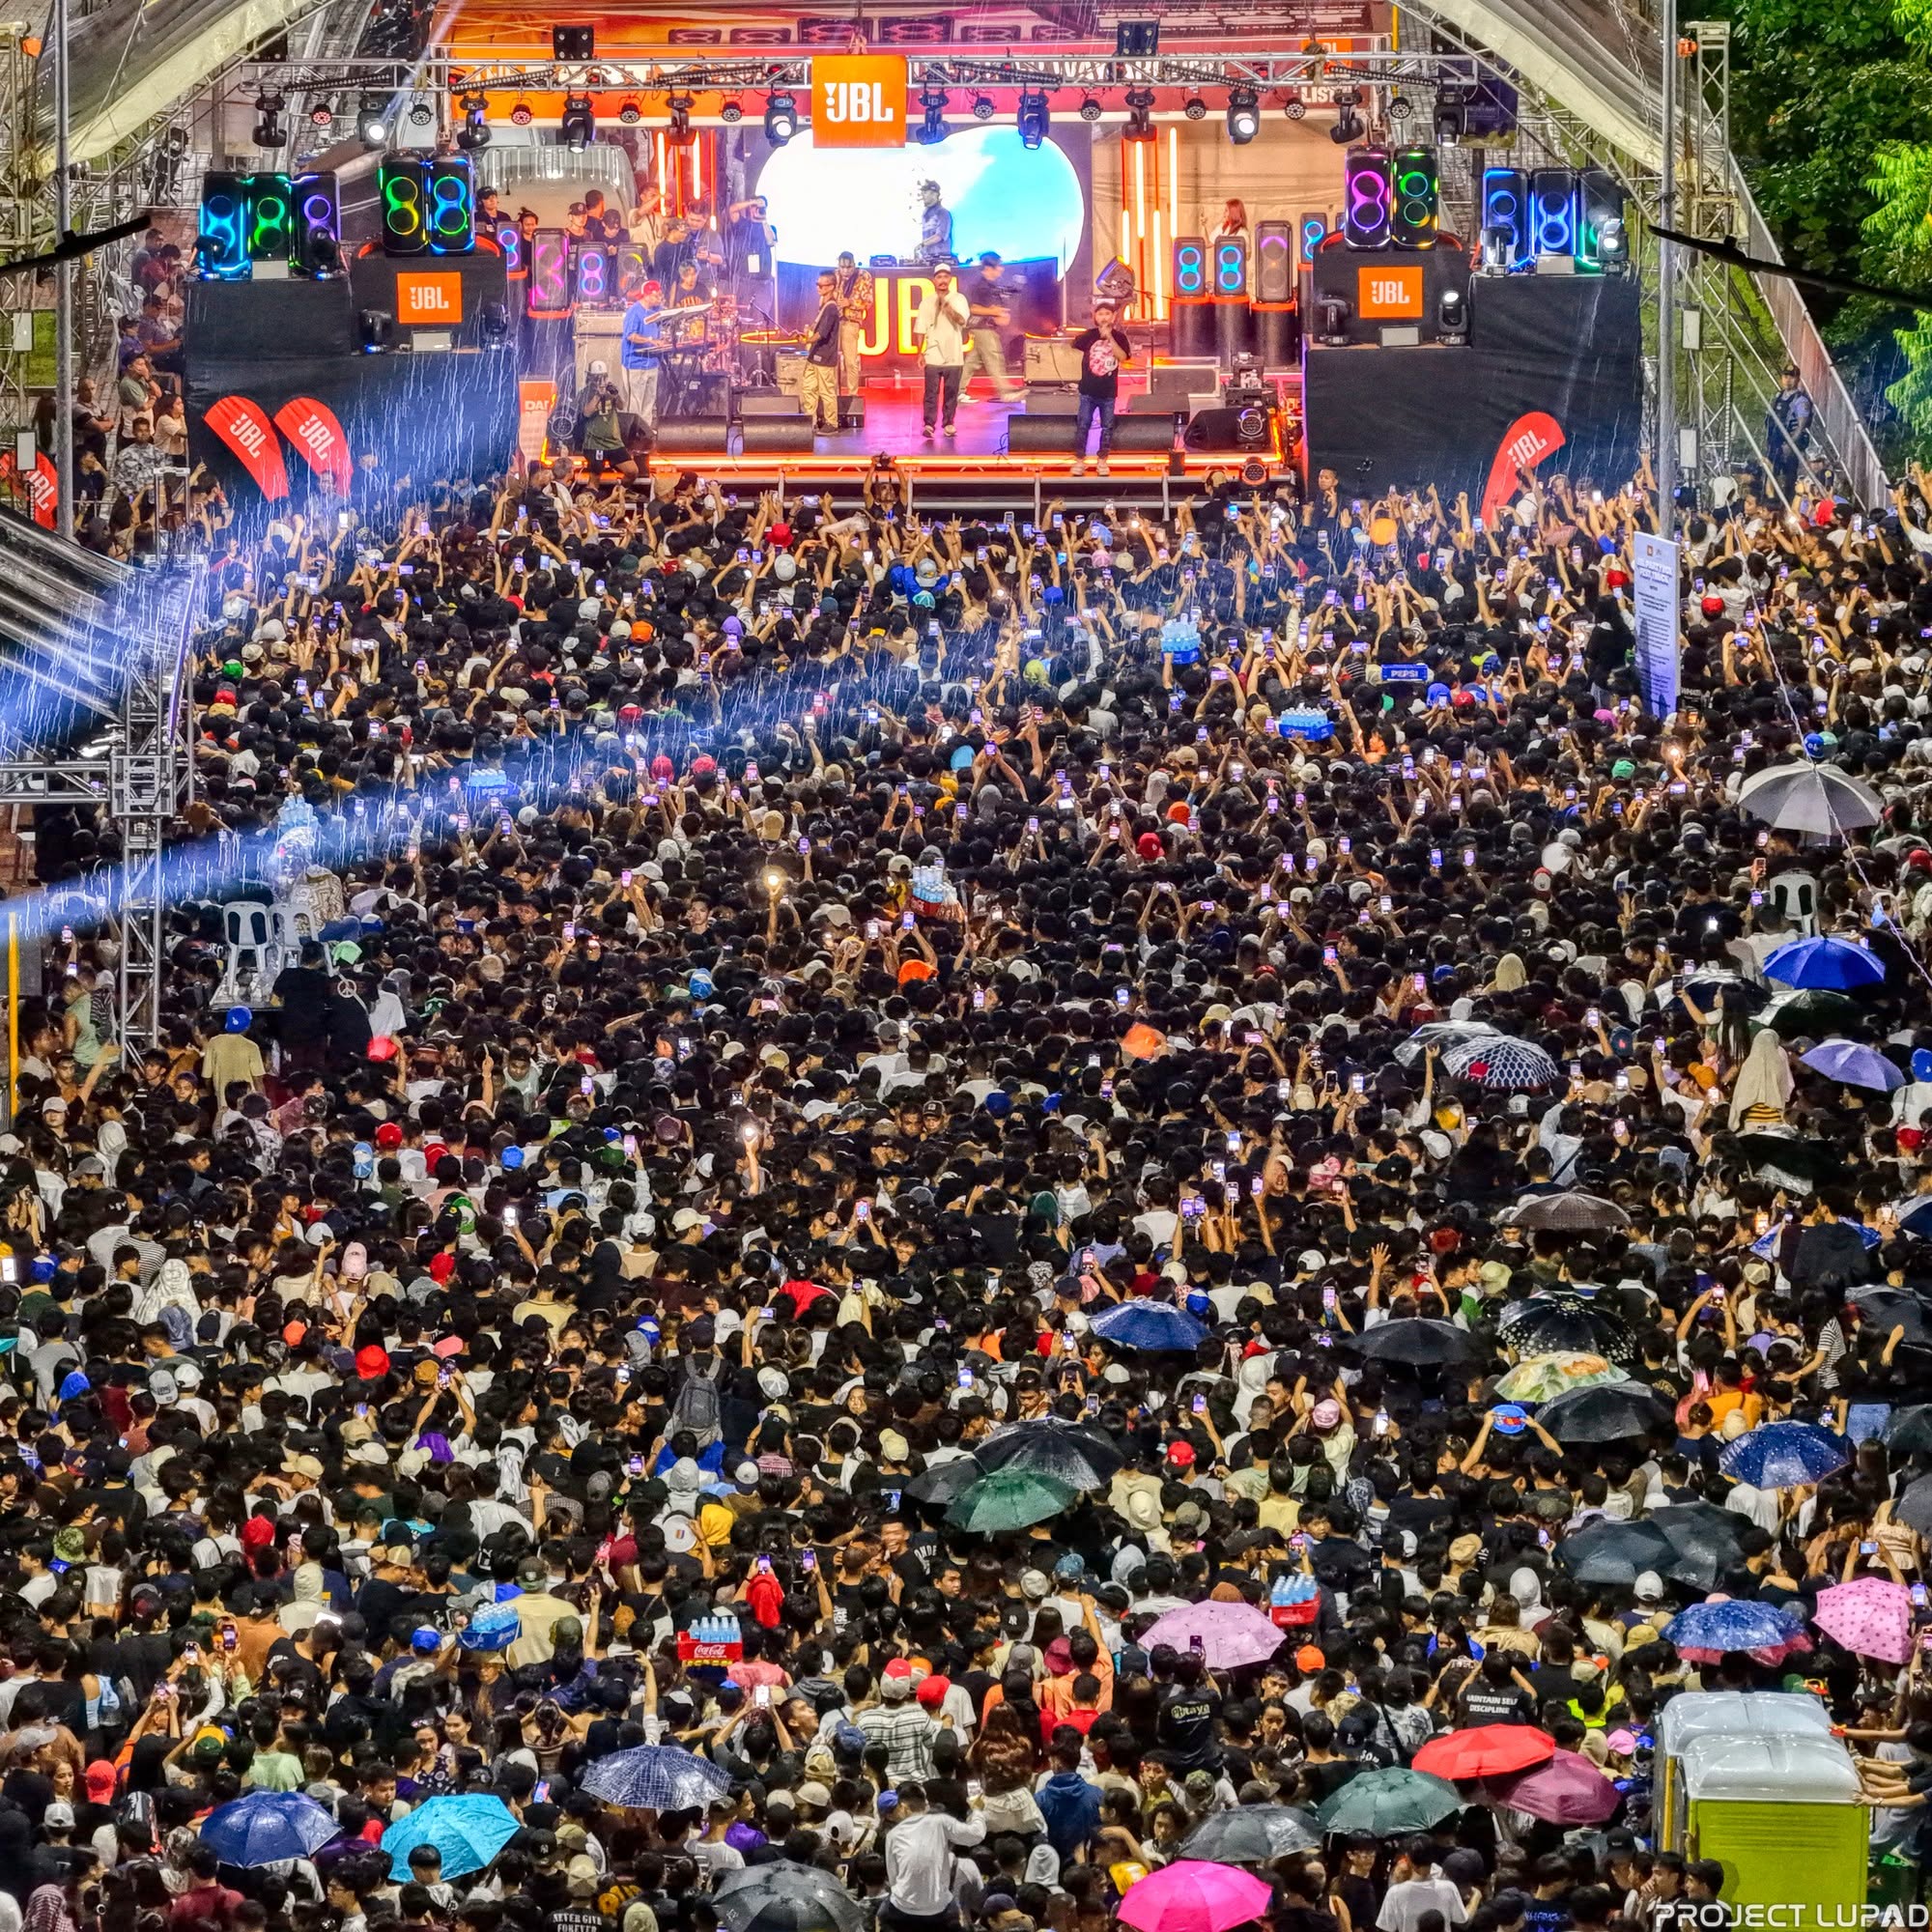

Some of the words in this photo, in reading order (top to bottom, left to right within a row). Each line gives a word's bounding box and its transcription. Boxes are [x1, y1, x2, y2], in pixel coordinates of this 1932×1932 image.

[824, 82, 894, 123] JBL
[410, 286, 449, 310] JBL
[1371, 280, 1410, 304] JBL
[230, 412, 267, 459] JBL
[298, 413, 335, 461] JBL
[1506, 429, 1548, 469] JBL
[1390, 669, 1418, 678] PEPSI
[481, 787, 509, 796] PEPSI
[1469, 1704, 1510, 1715] DISCIPLINE
[553, 1913, 582, 1923] NEVER
